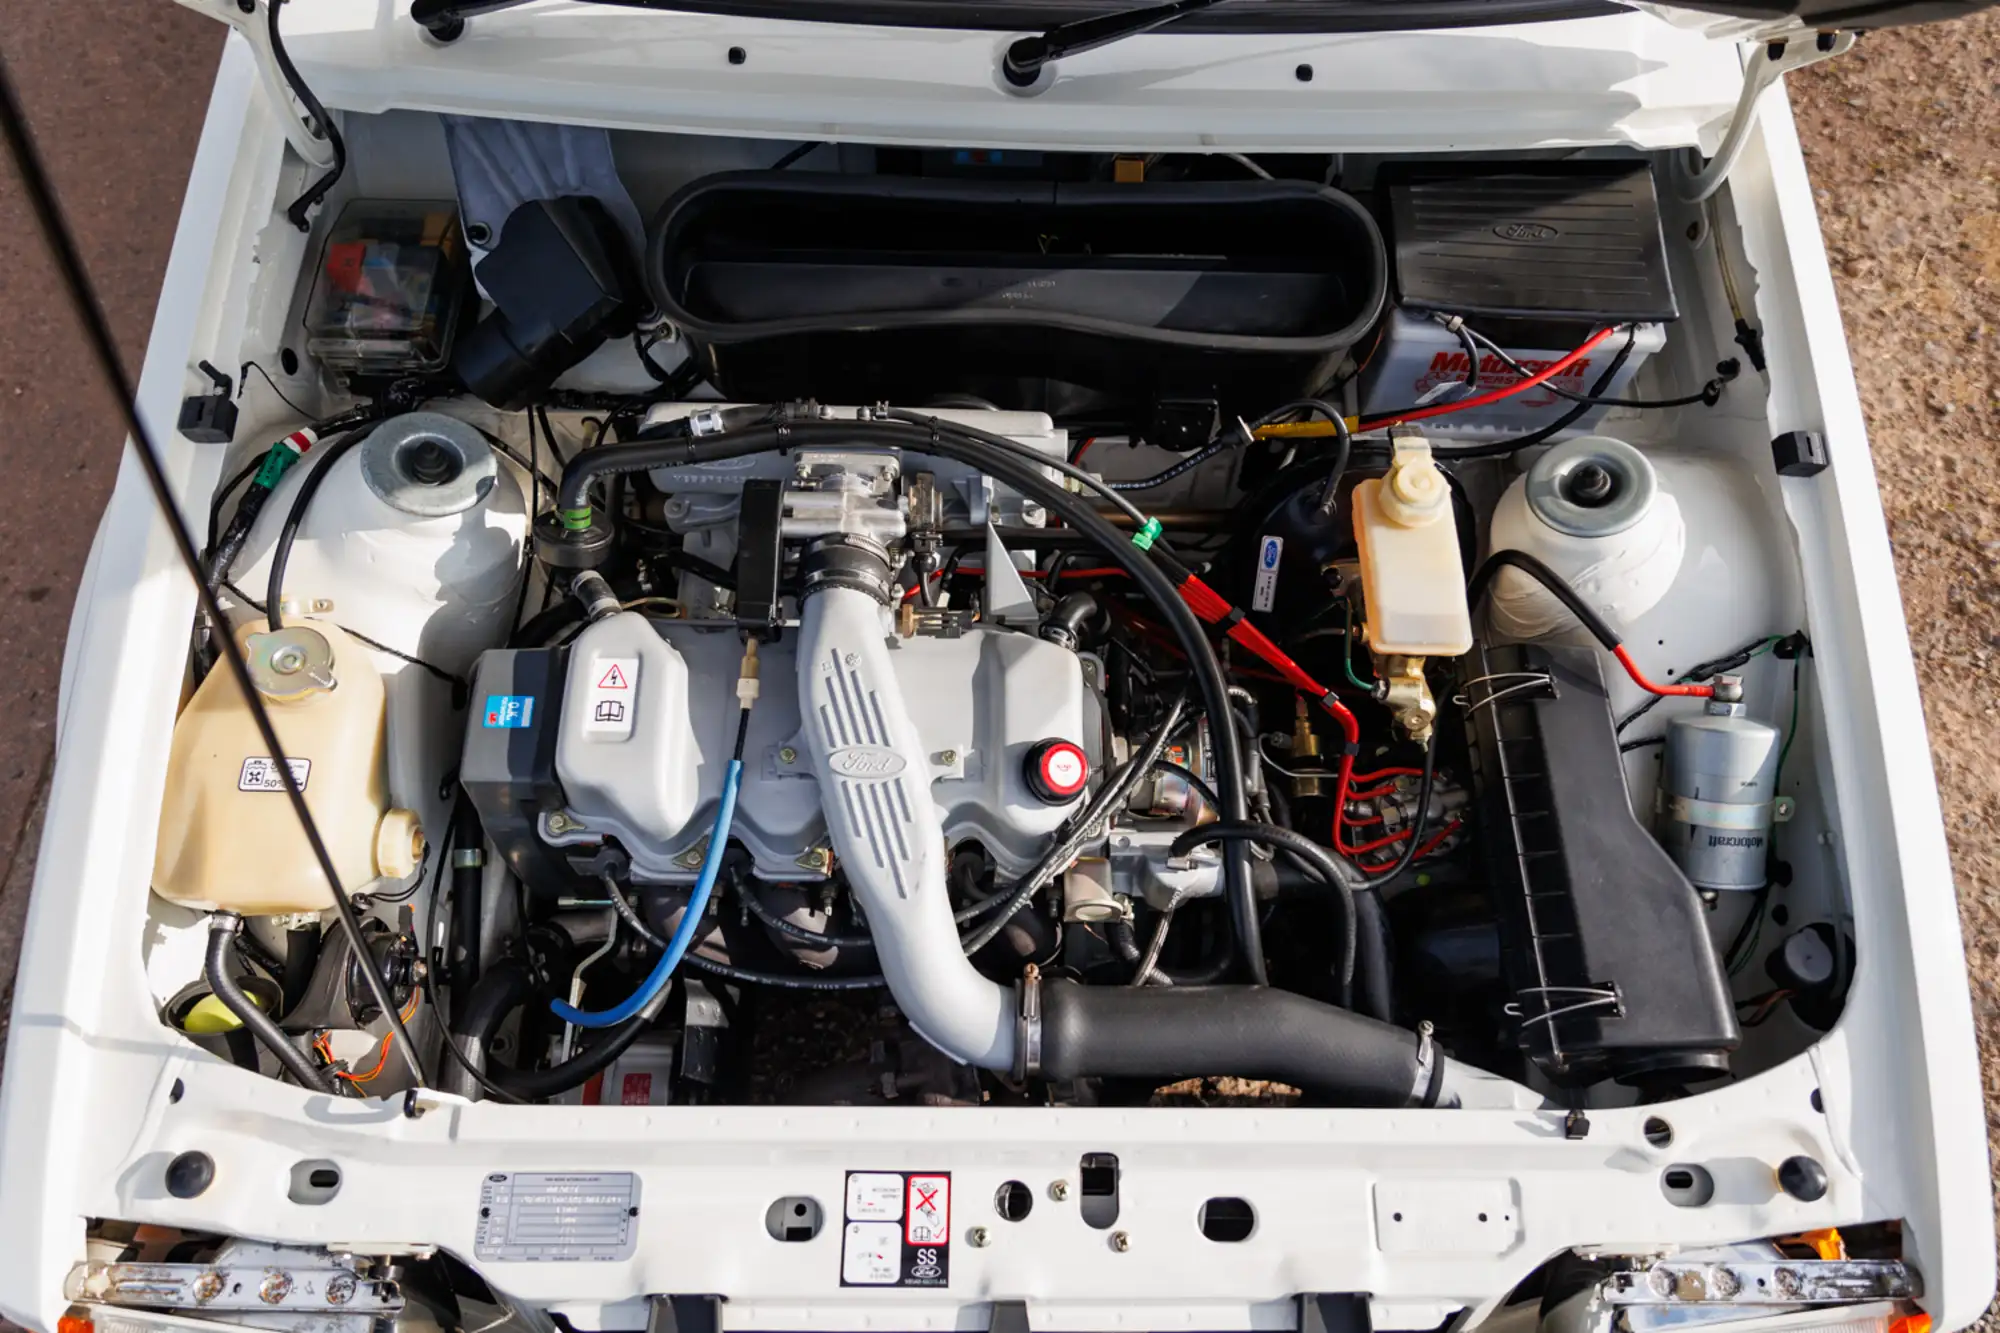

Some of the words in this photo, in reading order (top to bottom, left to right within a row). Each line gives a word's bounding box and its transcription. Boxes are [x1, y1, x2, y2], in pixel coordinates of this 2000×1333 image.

[1506, 225, 1546, 238] Ford
[842, 752, 891, 771] Ford
[1708, 835, 1764, 848] Motorcraft
[917, 1248, 937, 1265] SS
